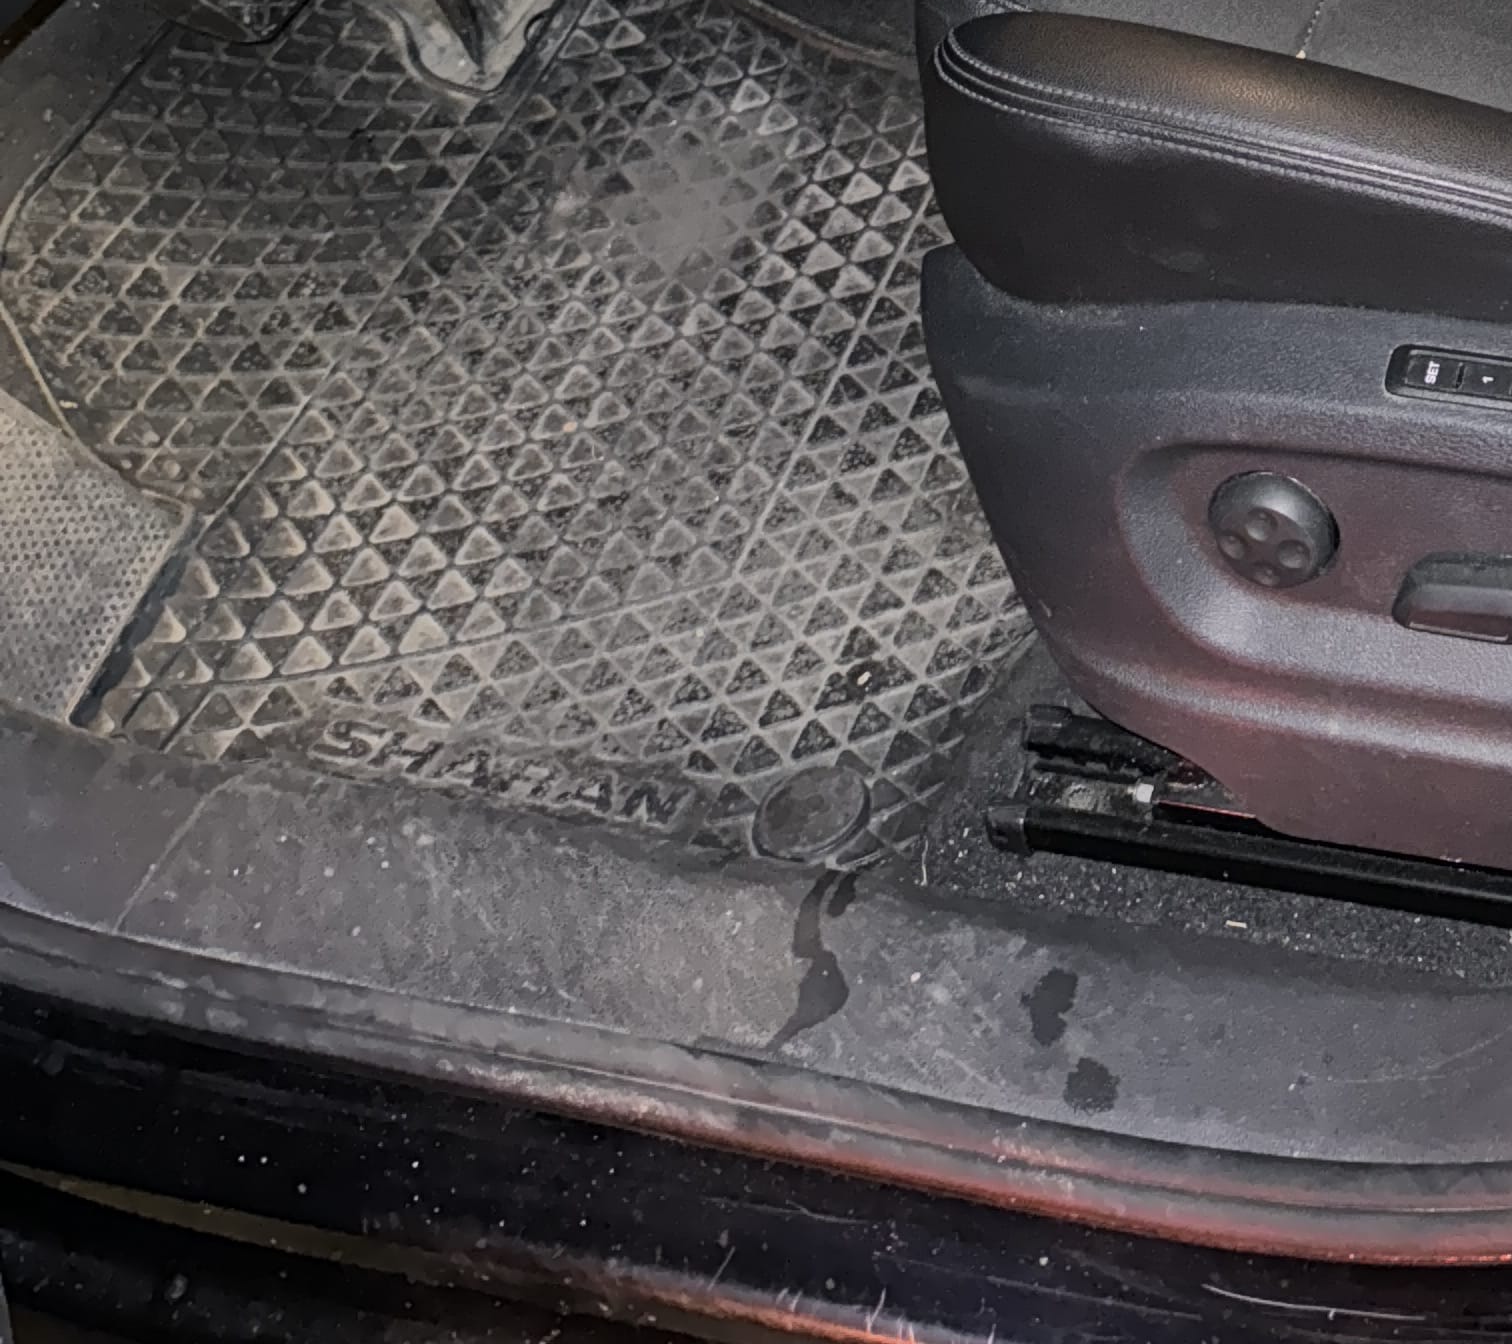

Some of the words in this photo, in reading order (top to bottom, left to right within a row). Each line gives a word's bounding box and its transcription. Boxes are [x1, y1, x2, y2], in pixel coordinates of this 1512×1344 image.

[1424, 360, 1441, 385] SET
[1482, 375, 1495, 385] 1
[308, 719, 692, 825] SHARAN
